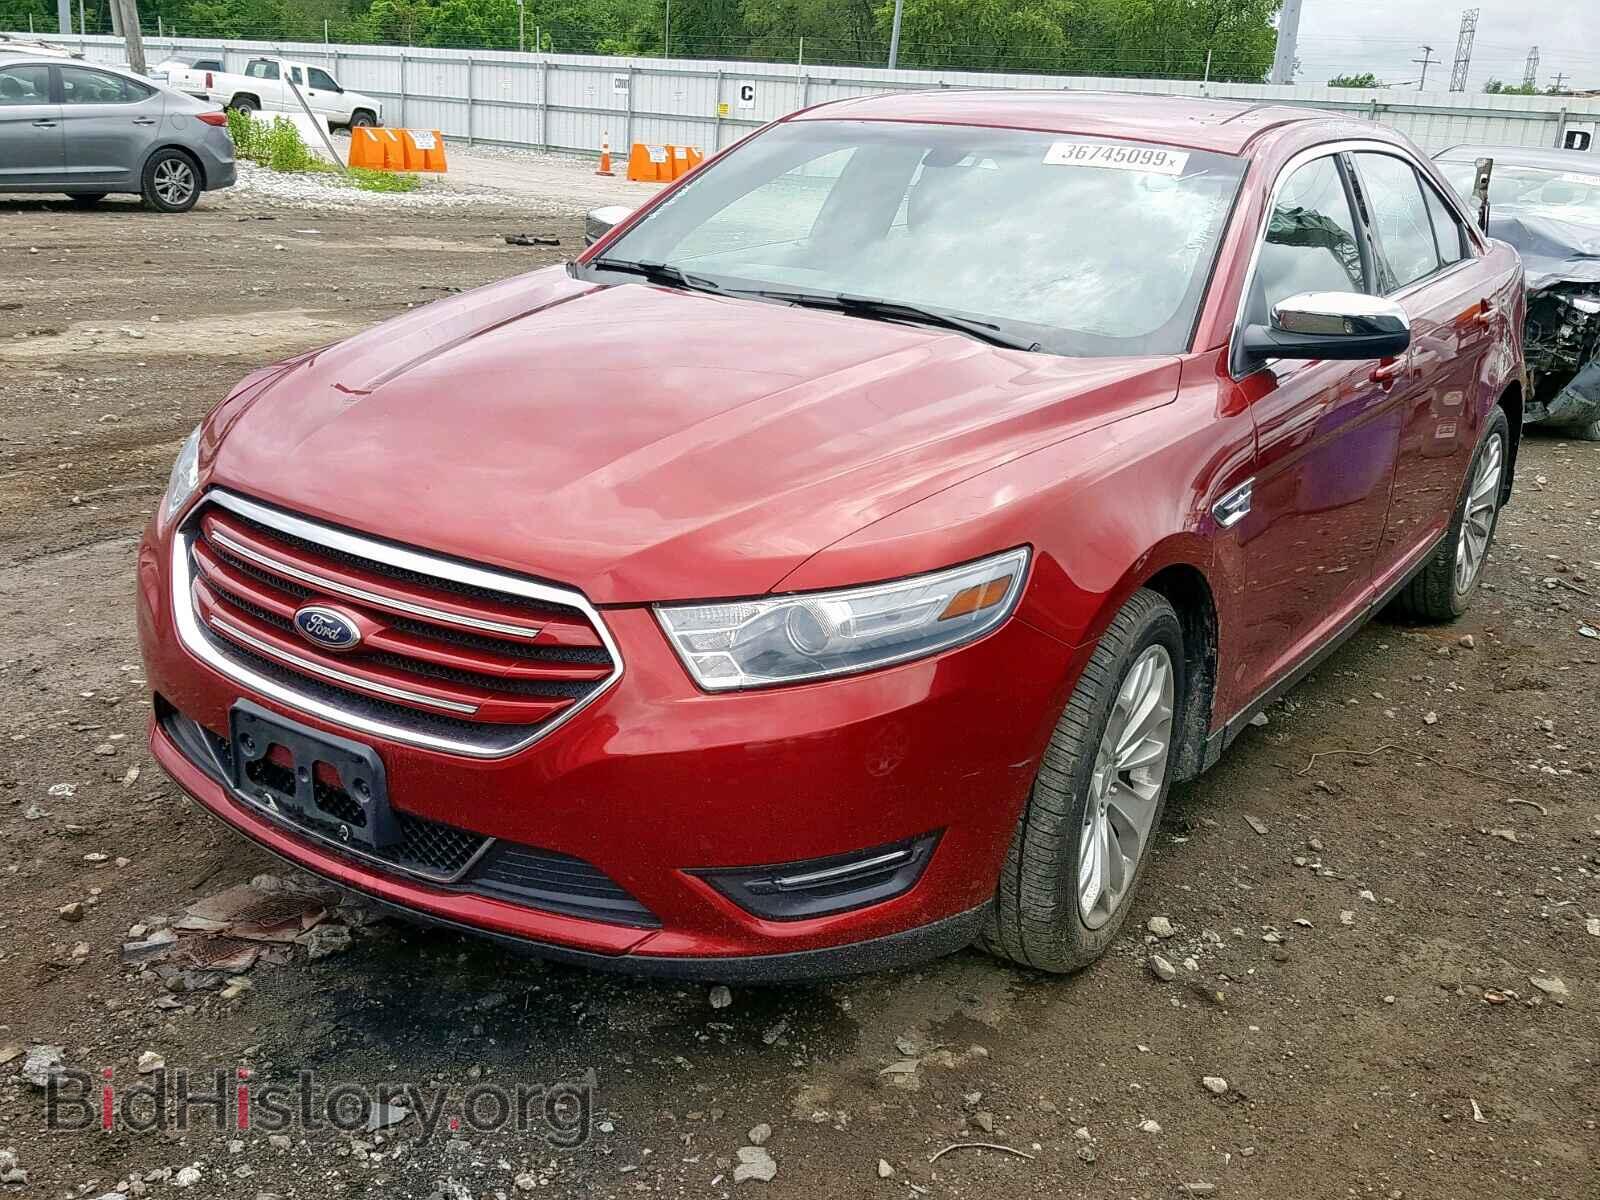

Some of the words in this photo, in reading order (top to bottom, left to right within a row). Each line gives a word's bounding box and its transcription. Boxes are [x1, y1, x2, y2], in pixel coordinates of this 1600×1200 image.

[741, 85, 754, 101] C
[1563, 130, 1592, 151] D
[306, 614, 342, 640] Ford
